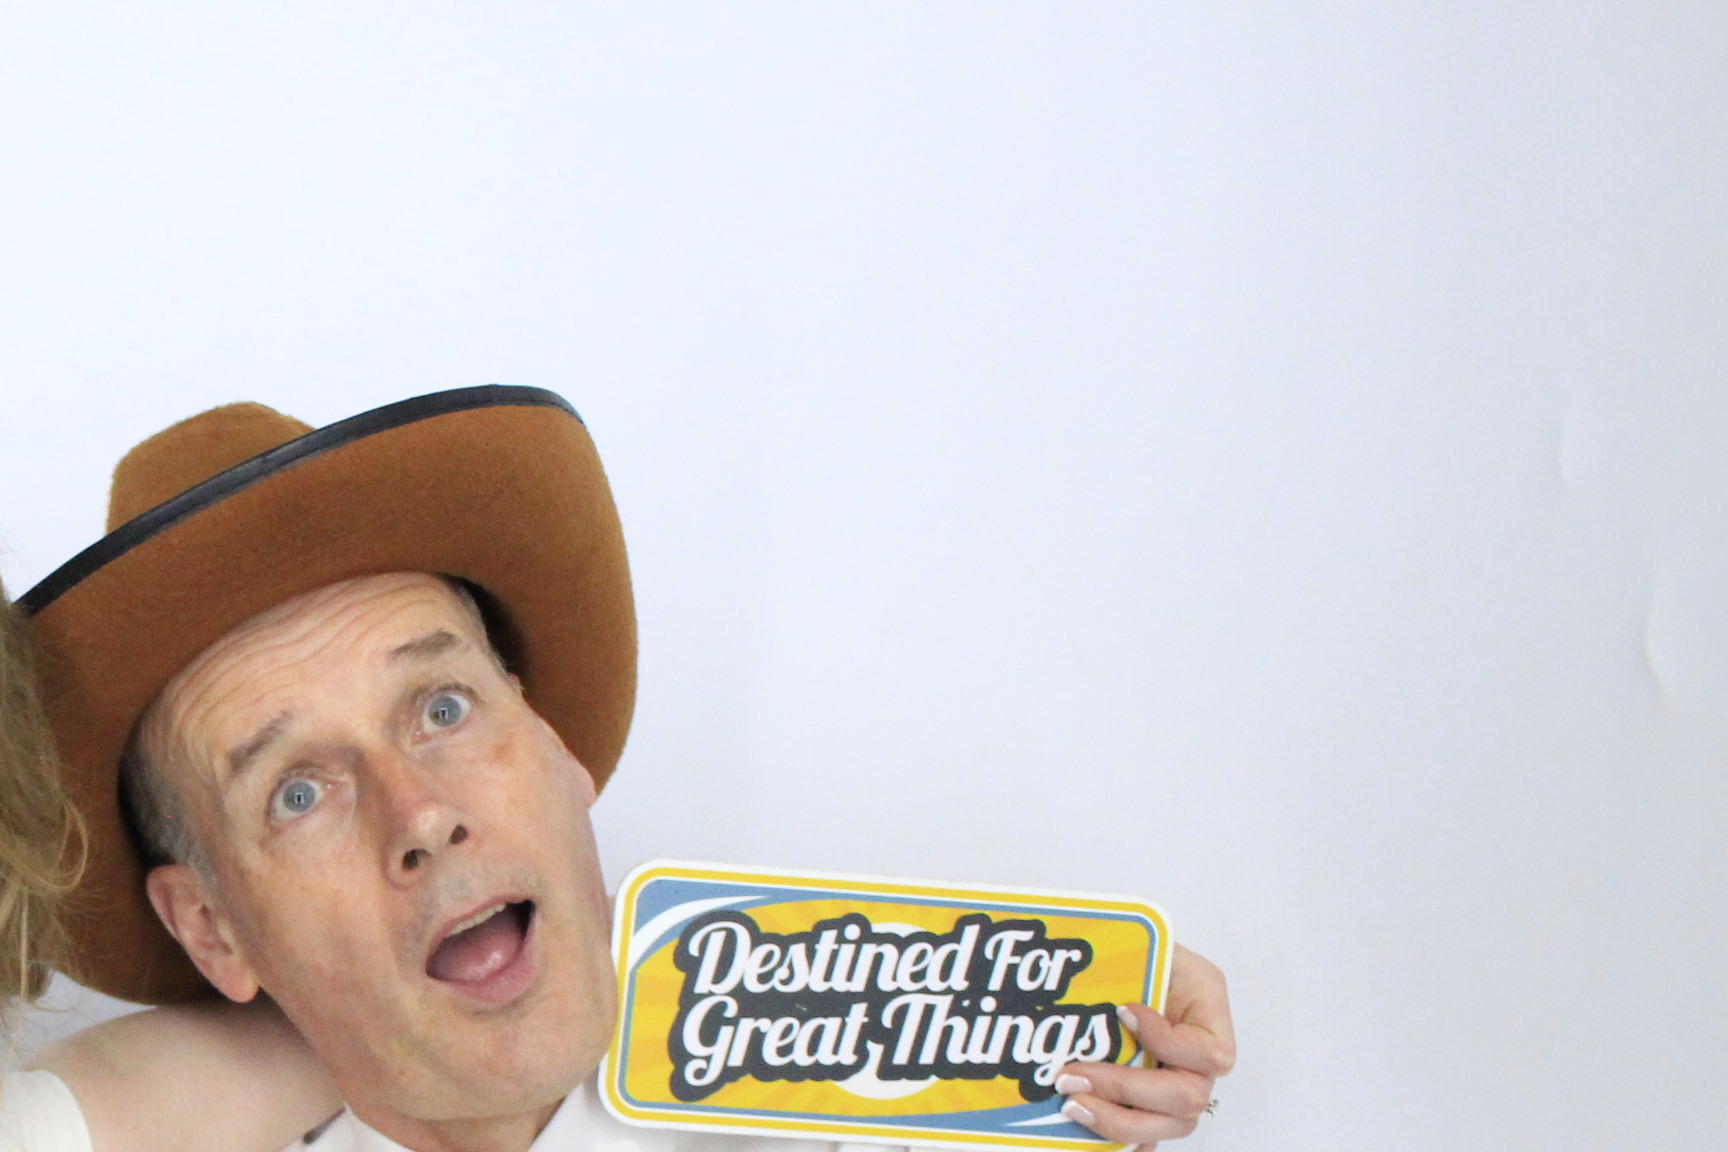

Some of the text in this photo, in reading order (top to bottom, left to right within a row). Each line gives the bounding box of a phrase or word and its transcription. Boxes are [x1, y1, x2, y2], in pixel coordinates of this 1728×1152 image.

[687, 921, 1083, 995] Destined For
[682, 993, 1113, 1088] Great Things
